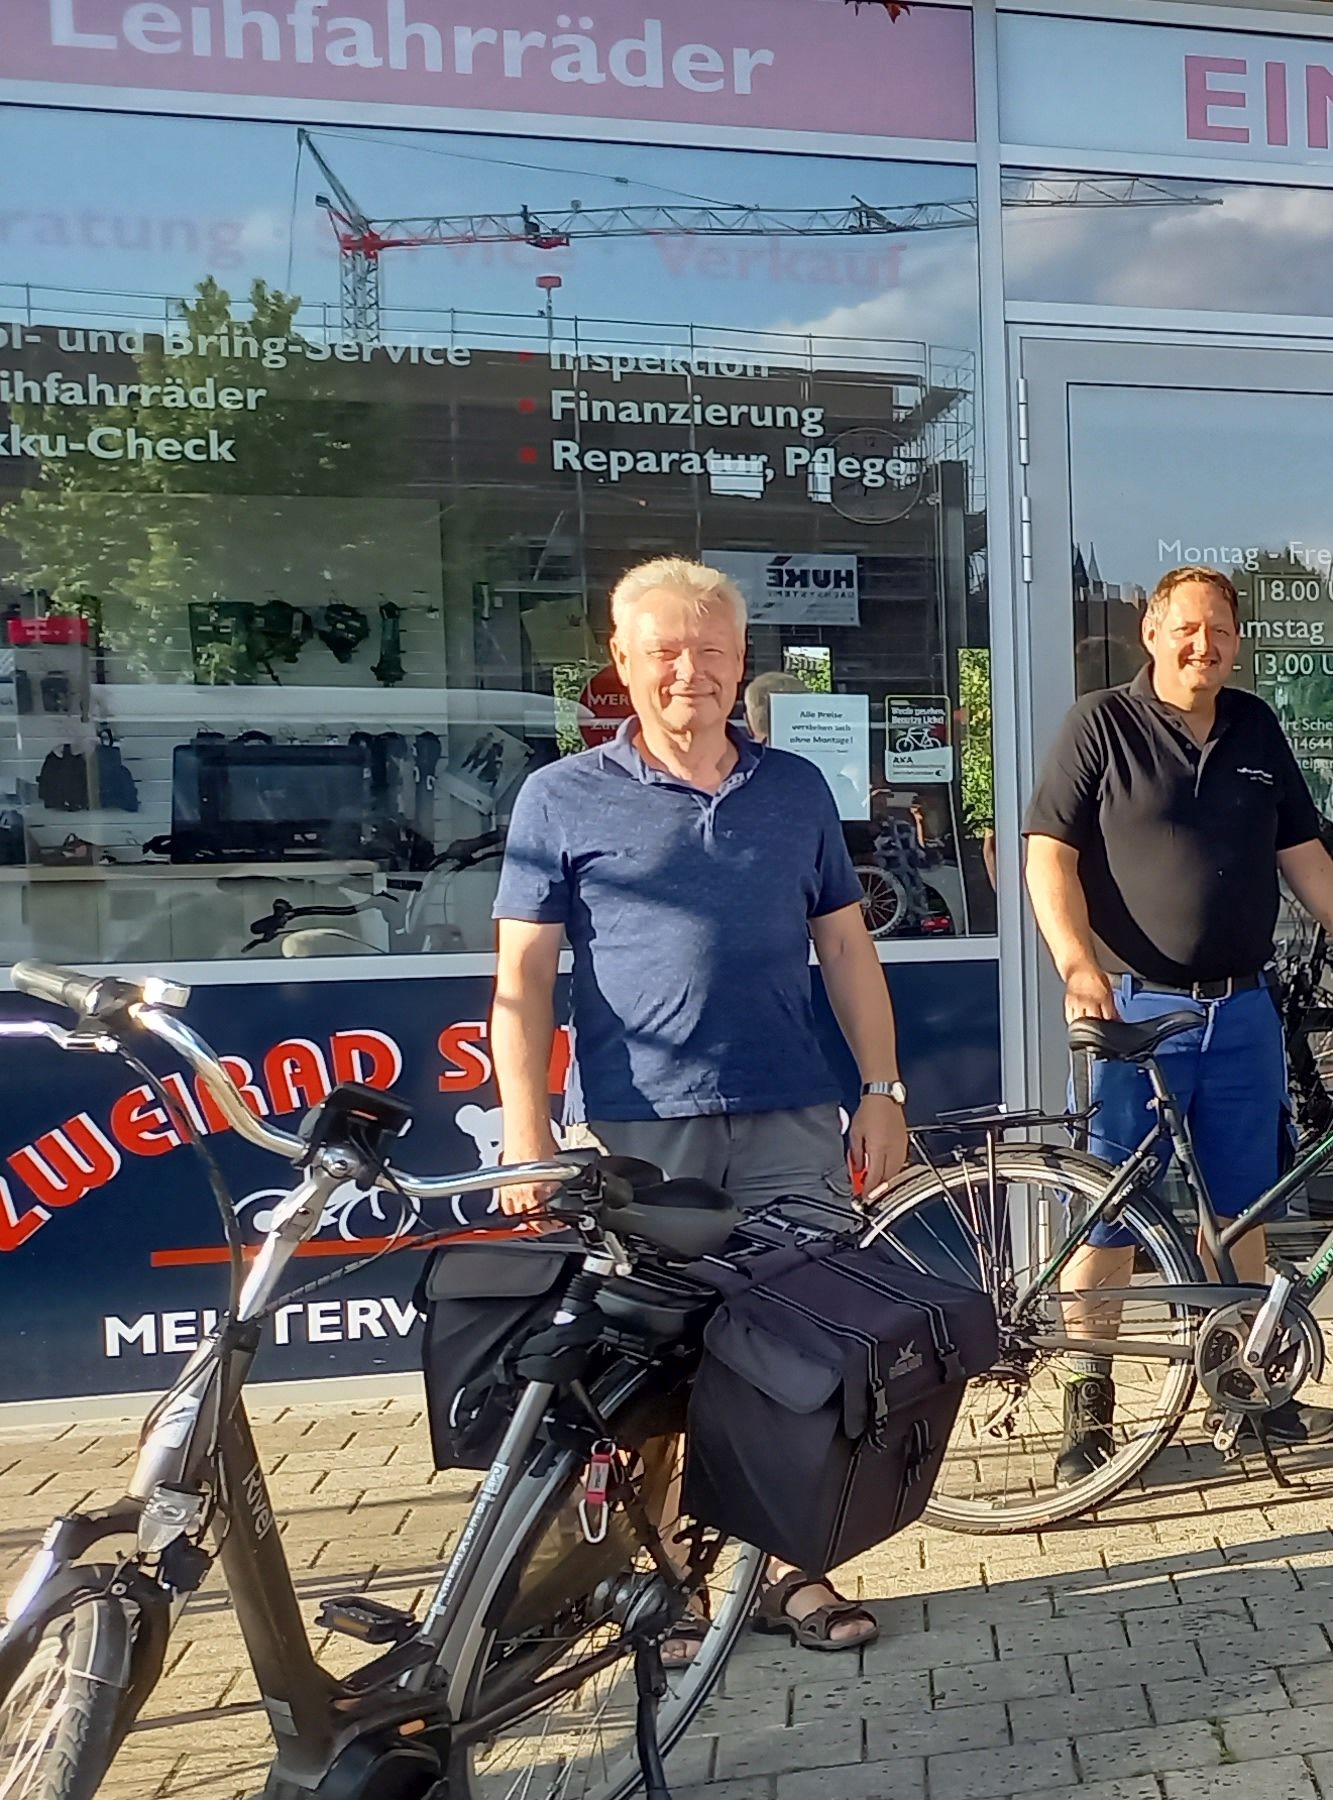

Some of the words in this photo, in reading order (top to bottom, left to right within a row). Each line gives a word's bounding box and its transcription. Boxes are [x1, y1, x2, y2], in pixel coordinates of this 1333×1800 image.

[51, 0, 775, 95] Leihfahrräder
[58, 327, 144, 354] und
[163, 322, 472, 368] Bring-Service
[549, 346, 769, 382] Inspektion
[551, 390, 826, 438] Finanzierung
[552, 439, 775, 483] Reparatur,
[784, 446, 917, 488] Pflege
[1158, 539, 1259, 571] Montag
[1260, 580, 1320, 602] 18.00
[1254, 653, 1314, 675] 13.00
[790, 736, 811, 744] ohne
[813, 736, 854, 746] Montage!
[0, 1028, 404, 1252] ZWEIRAD
[241, 1462, 275, 1541] Rivel
